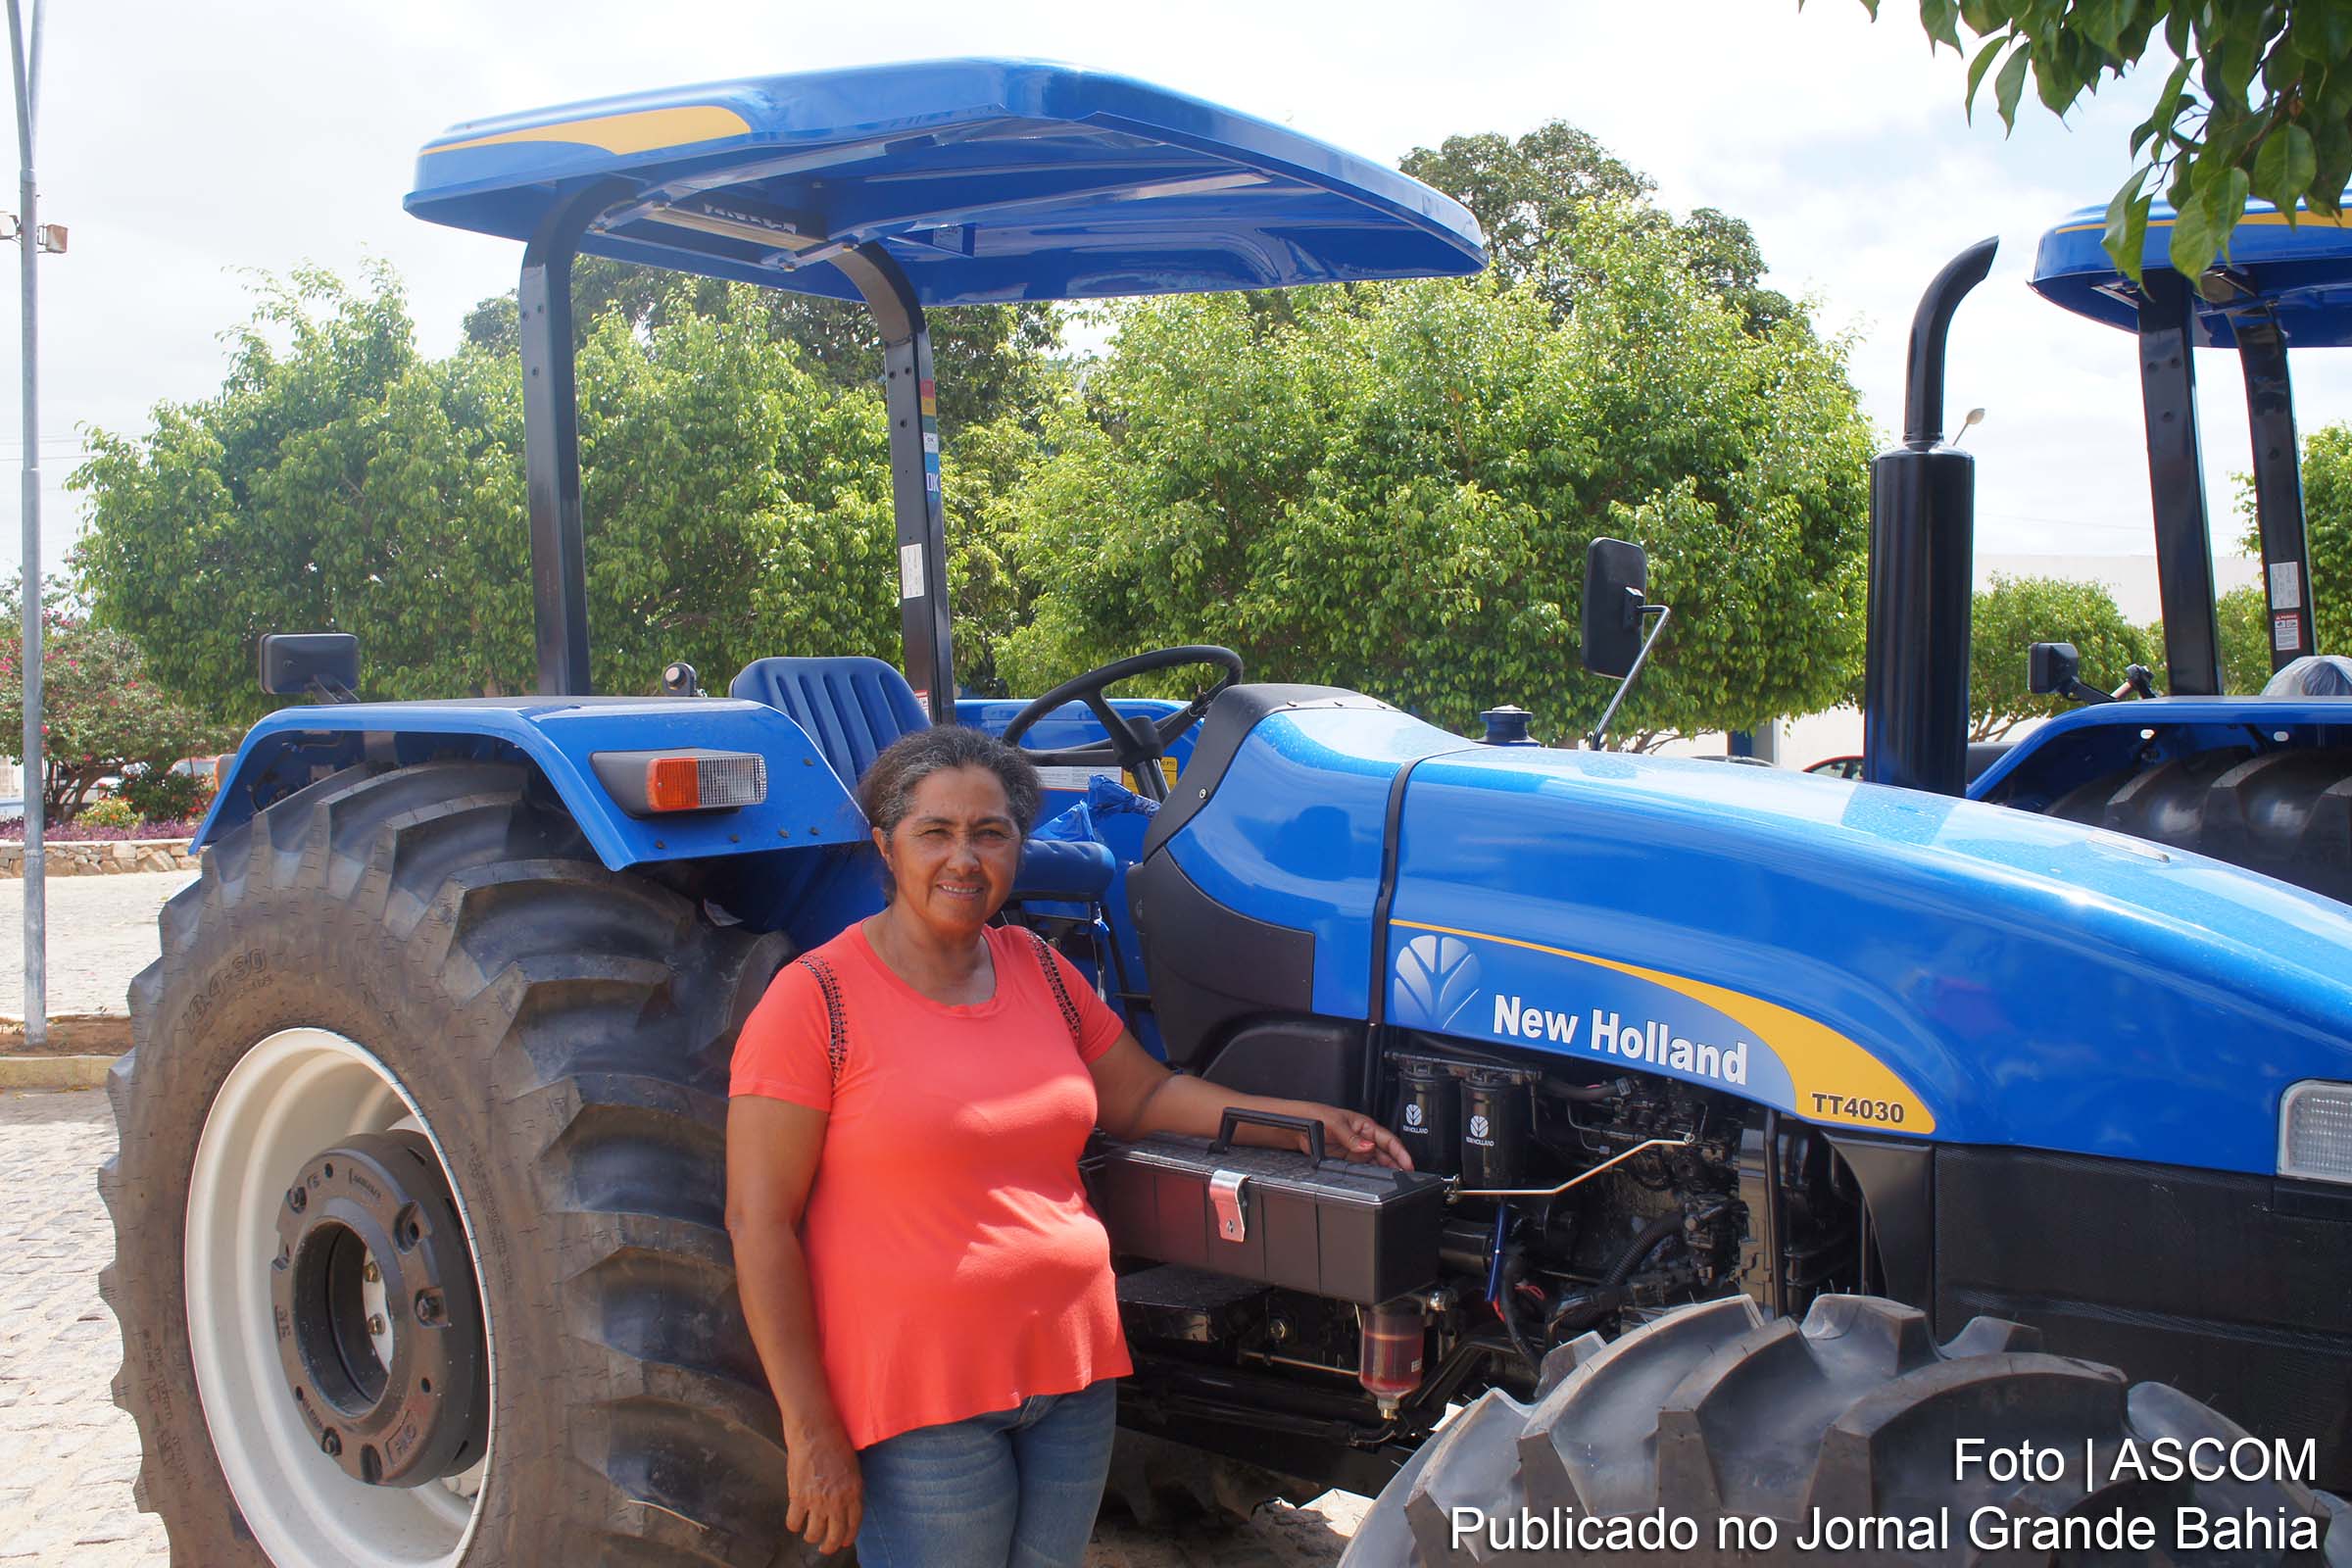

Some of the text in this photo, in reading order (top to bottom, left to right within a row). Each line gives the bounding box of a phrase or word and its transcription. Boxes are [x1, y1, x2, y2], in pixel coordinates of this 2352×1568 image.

[926, 471, 940, 493] OK
[1493, 994, 1748, 1086] New Holland
[1812, 1092, 1906, 1124] TT4030
